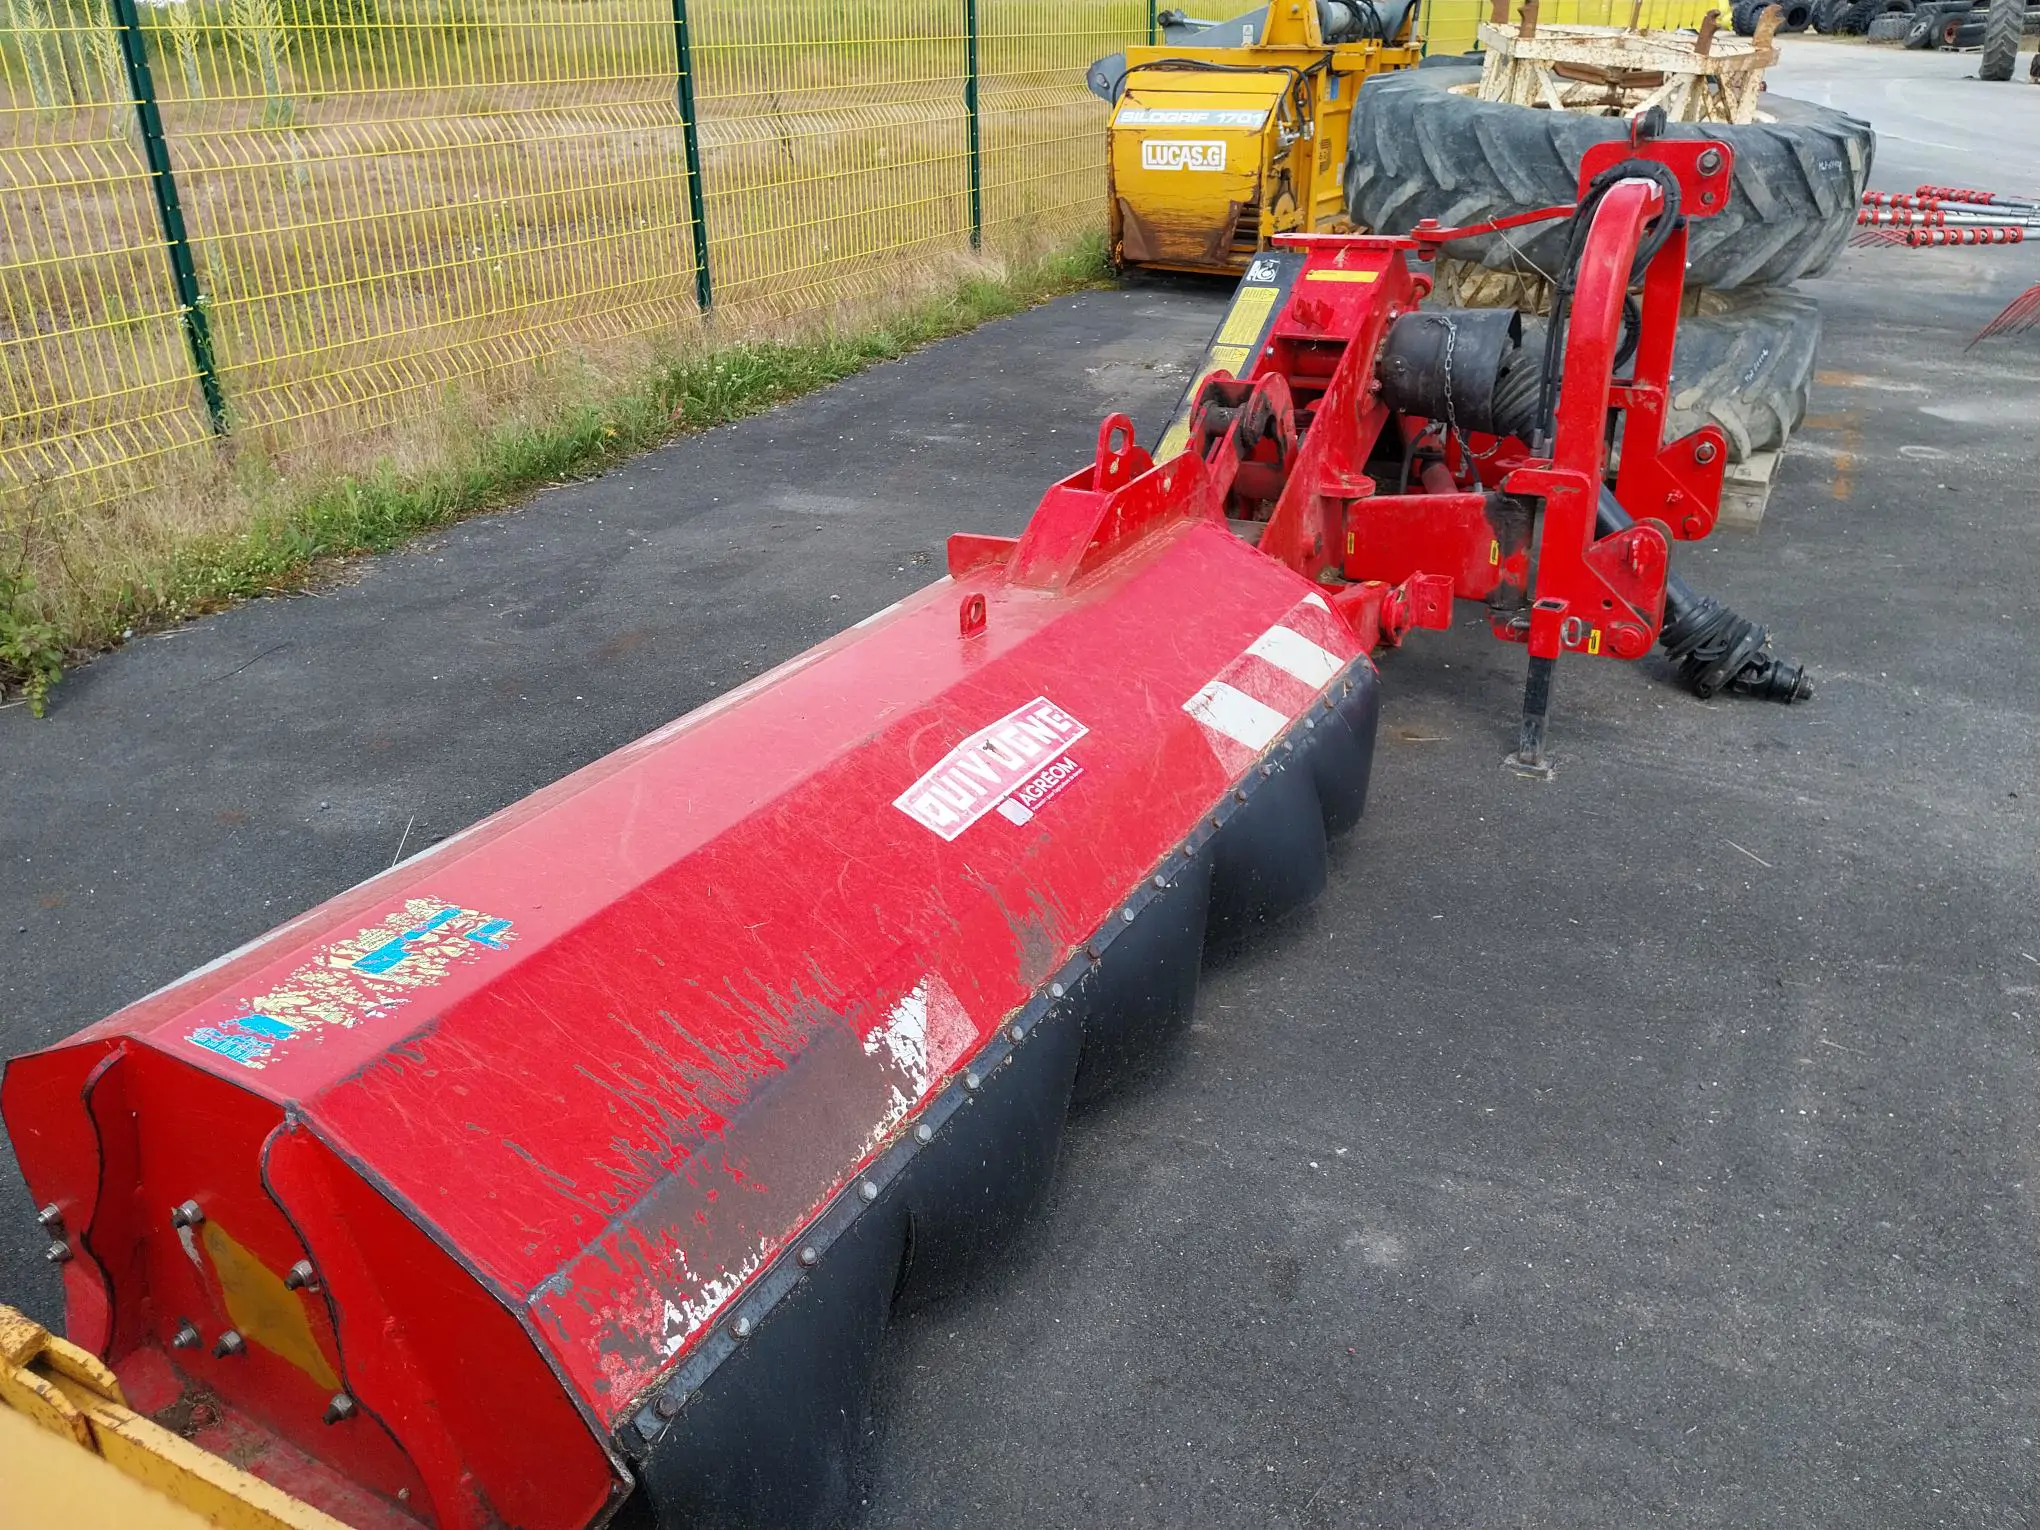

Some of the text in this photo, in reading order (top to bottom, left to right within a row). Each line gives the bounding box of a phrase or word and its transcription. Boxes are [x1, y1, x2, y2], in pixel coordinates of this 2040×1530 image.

[1120, 111, 1209, 123] SILOGRIF
[1146, 145, 1221, 166] LUCAS.G
[1019, 756, 1079, 807] AGRÉOM
